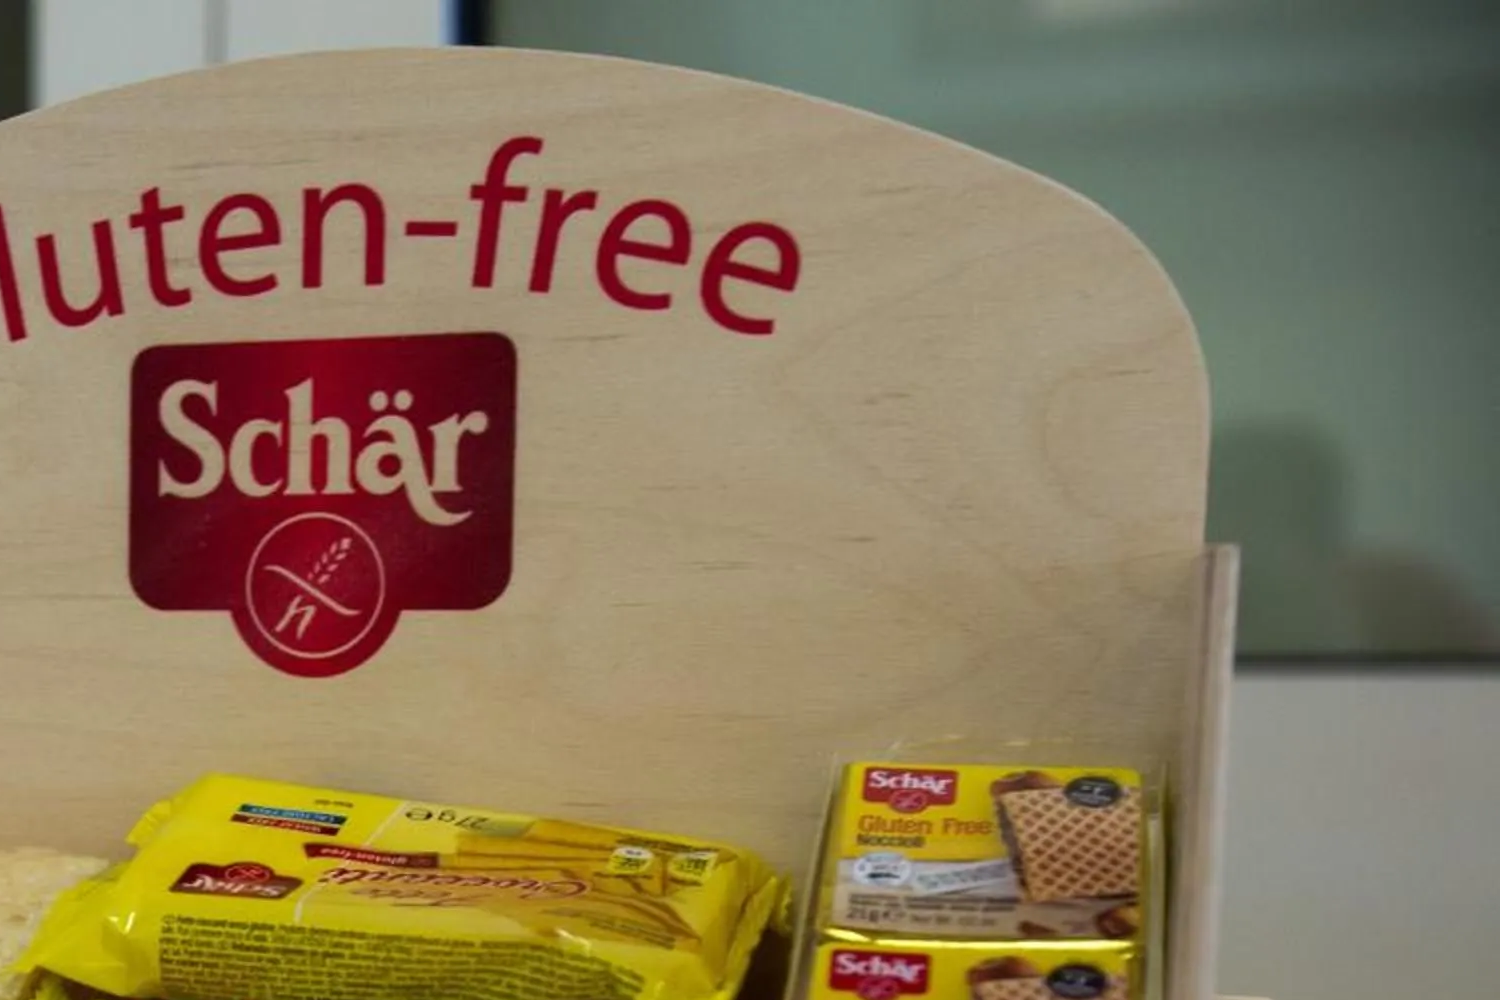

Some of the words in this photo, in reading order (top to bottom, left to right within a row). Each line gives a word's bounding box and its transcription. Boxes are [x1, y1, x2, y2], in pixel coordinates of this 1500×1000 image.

[157, 377, 490, 527] Schär
[868, 769, 953, 794] Schär
[858, 815, 933, 836] Gluten
[942, 818, 995, 836] Free
[183, 873, 289, 897] Schär
[835, 952, 927, 981] Schär
